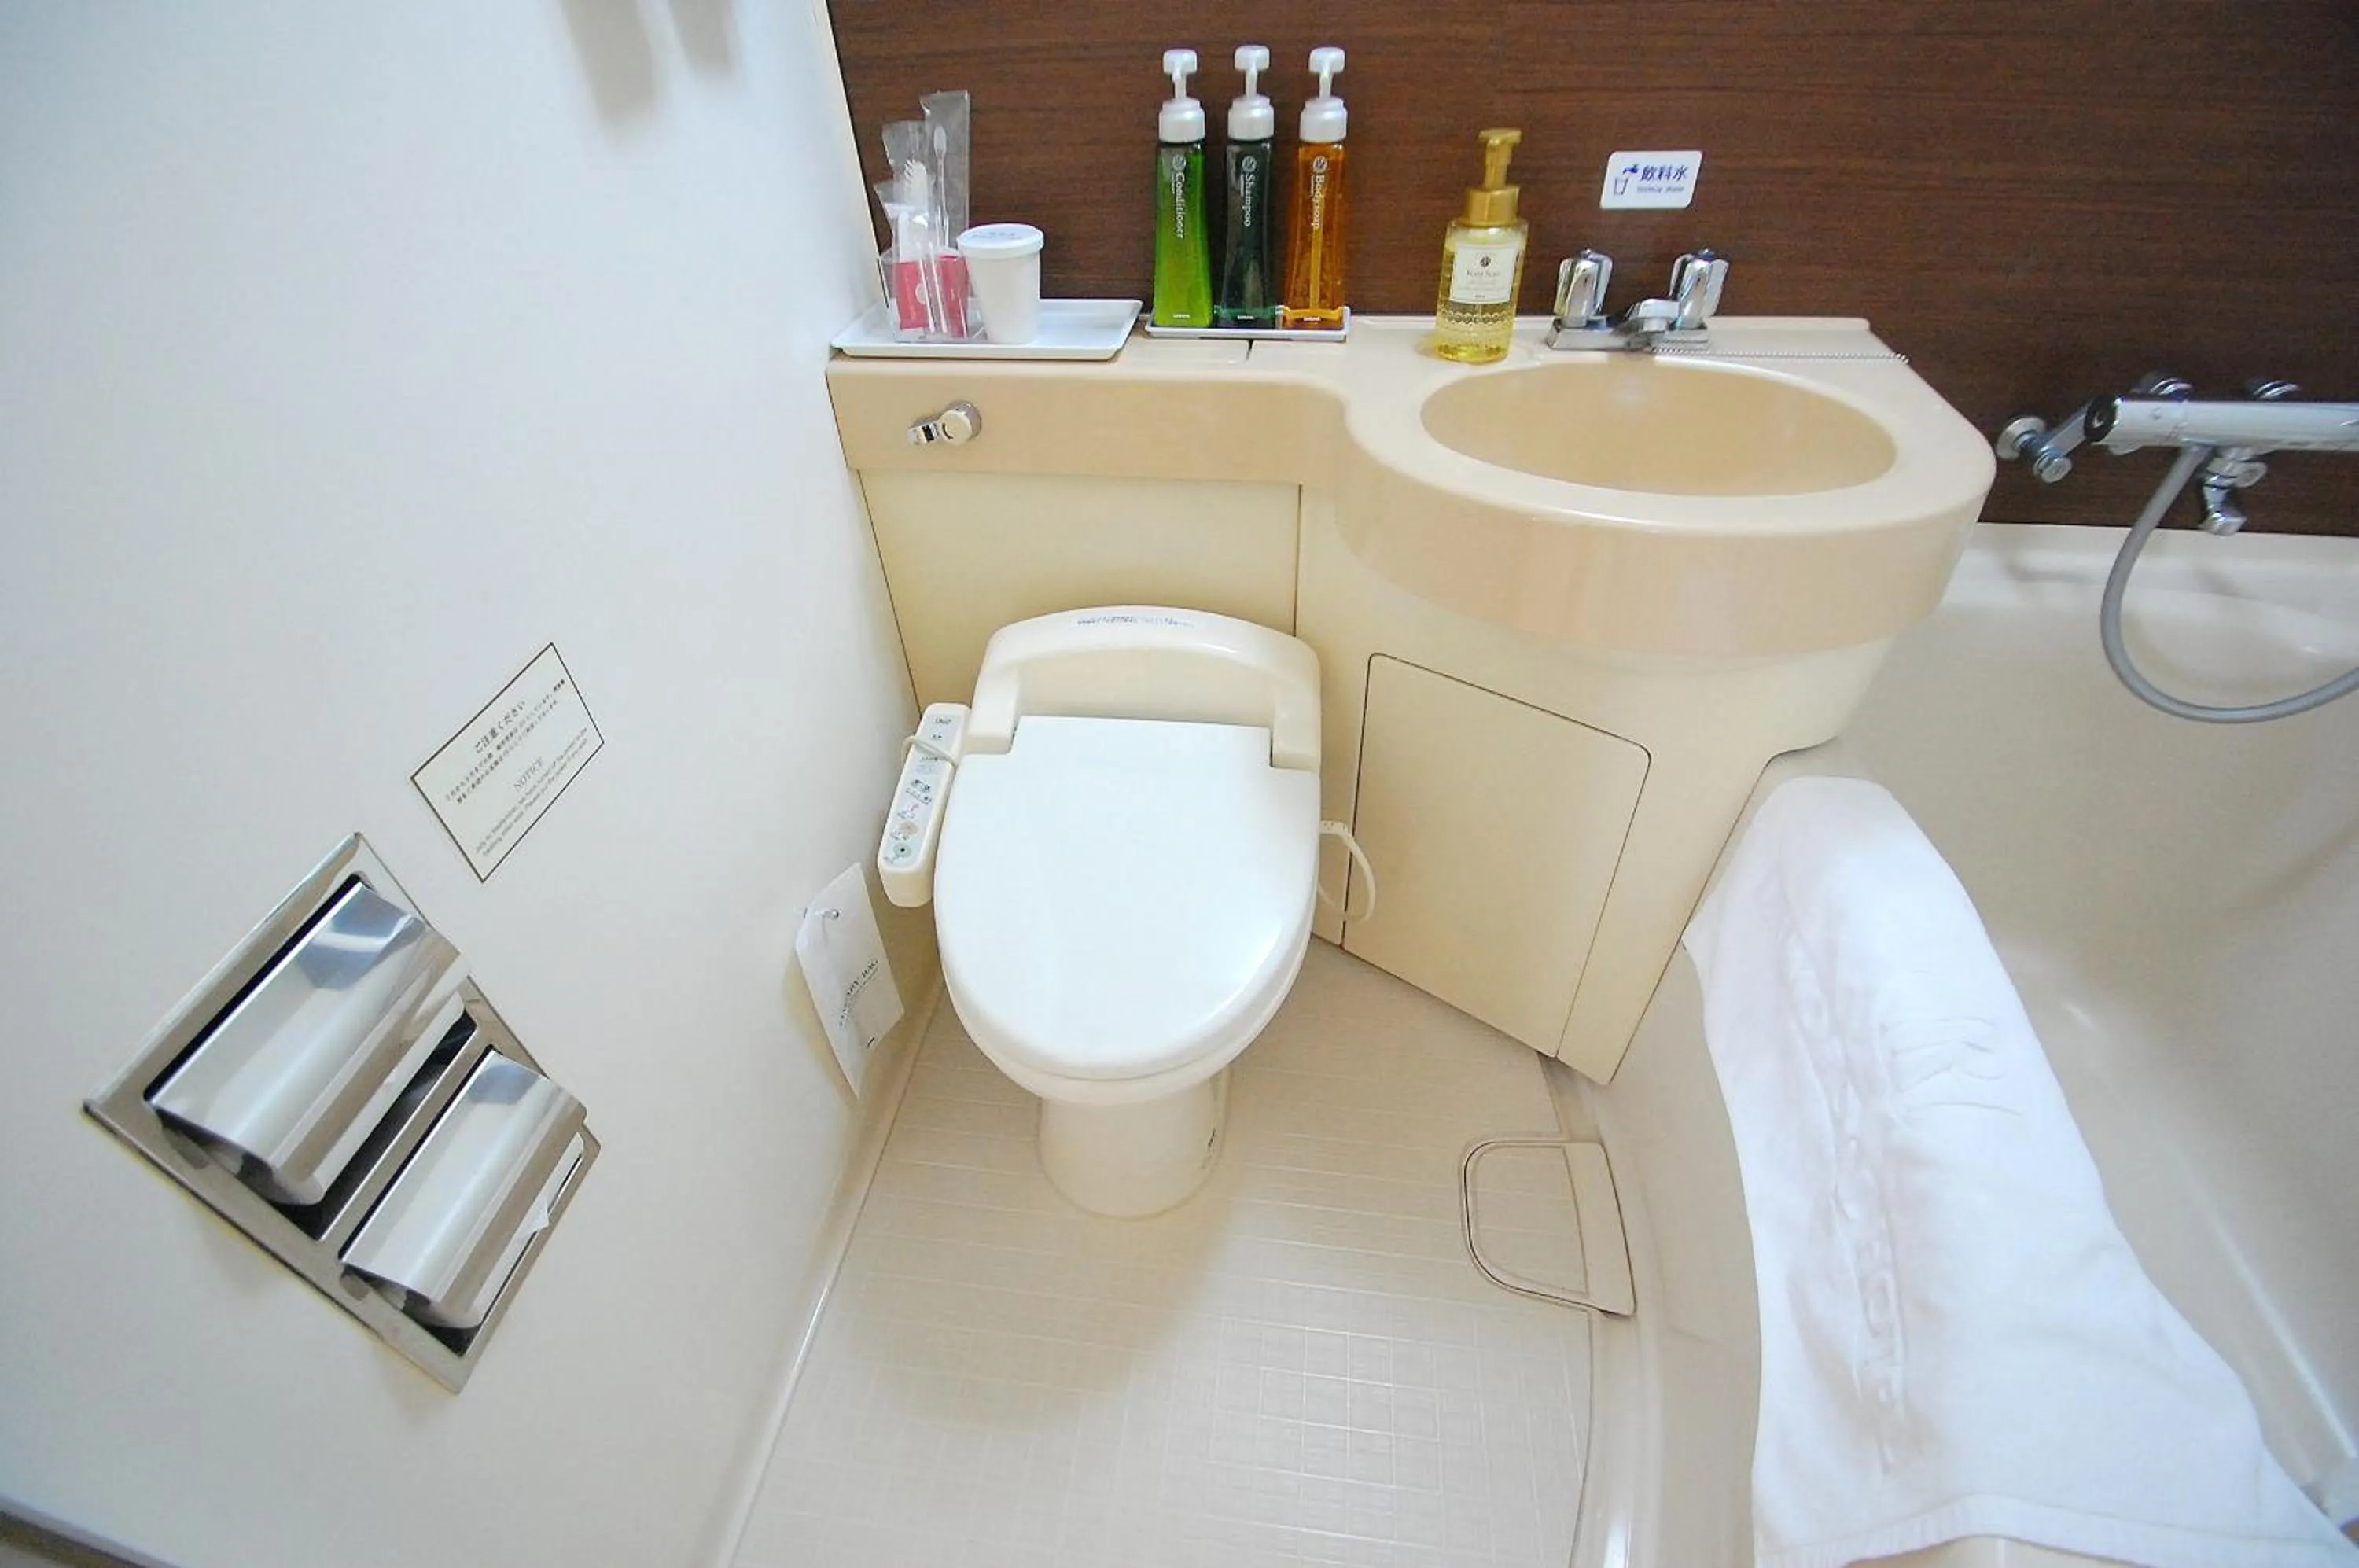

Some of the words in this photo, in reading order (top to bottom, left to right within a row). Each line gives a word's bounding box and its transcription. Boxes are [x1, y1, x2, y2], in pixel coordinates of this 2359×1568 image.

[1640, 164, 1689, 182] 飲料水
[1176, 171, 1187, 239] Conditioner
[1242, 173, 1252, 227] Shampoo
[513, 756, 543, 792] NOTICE
